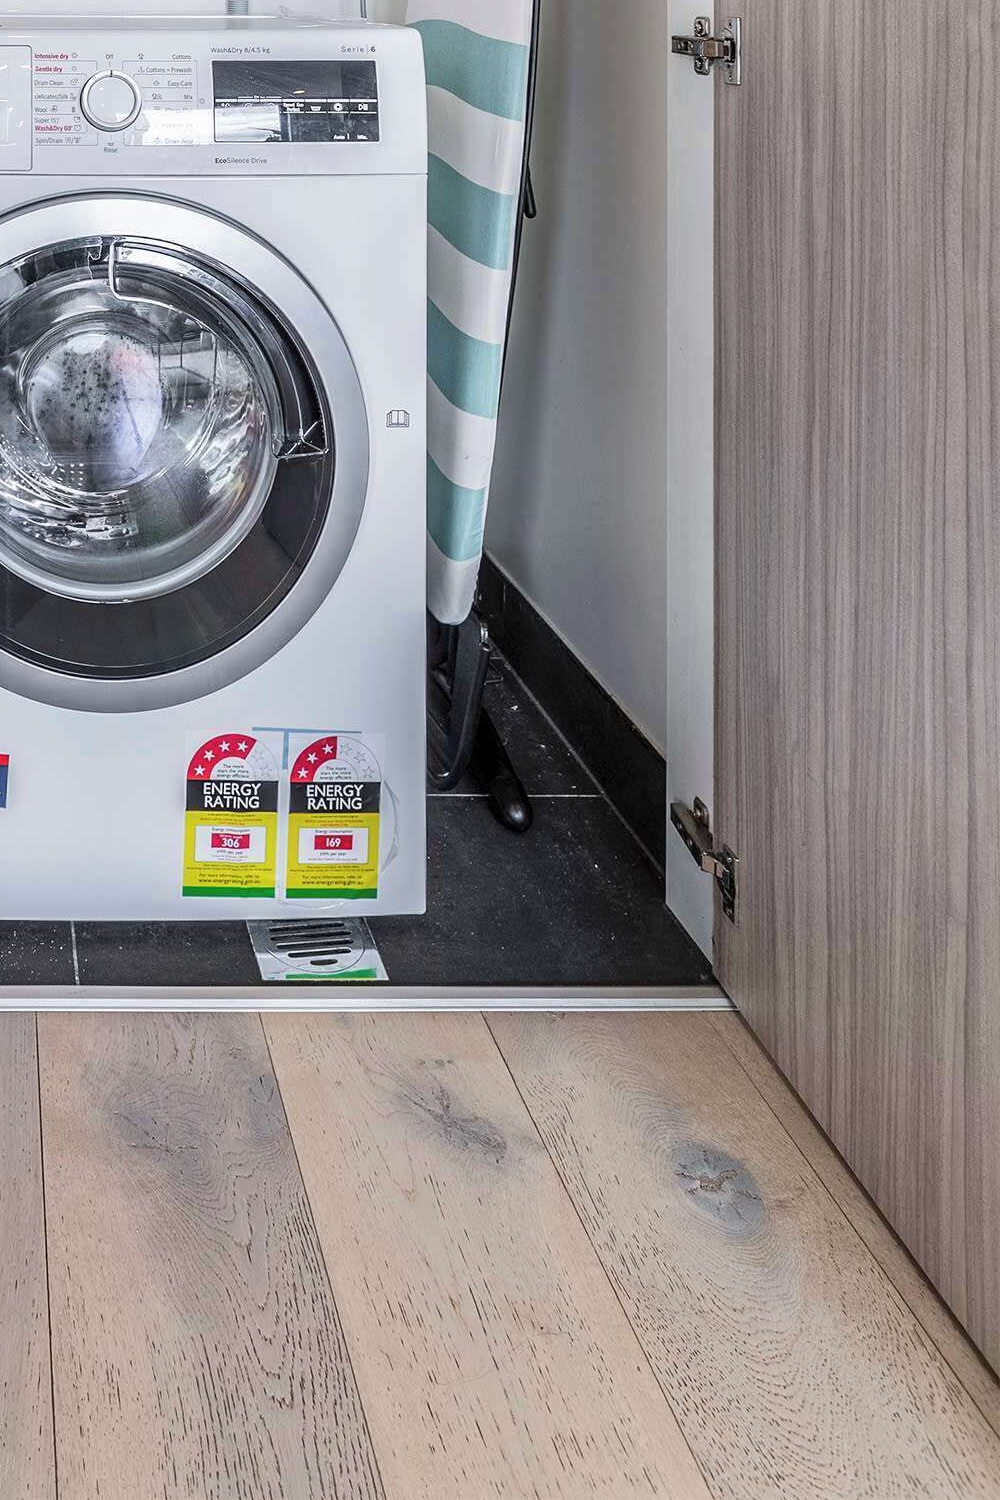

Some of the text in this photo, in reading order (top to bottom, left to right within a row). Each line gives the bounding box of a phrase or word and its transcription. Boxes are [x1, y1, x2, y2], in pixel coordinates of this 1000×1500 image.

[203, 783, 261, 796] ENERGY
[306, 784, 364, 797] ENERGY
[204, 796, 260, 809] RATING
[308, 798, 362, 810] RATING
[222, 838, 239, 848] 306
[326, 838, 341, 847] 169
